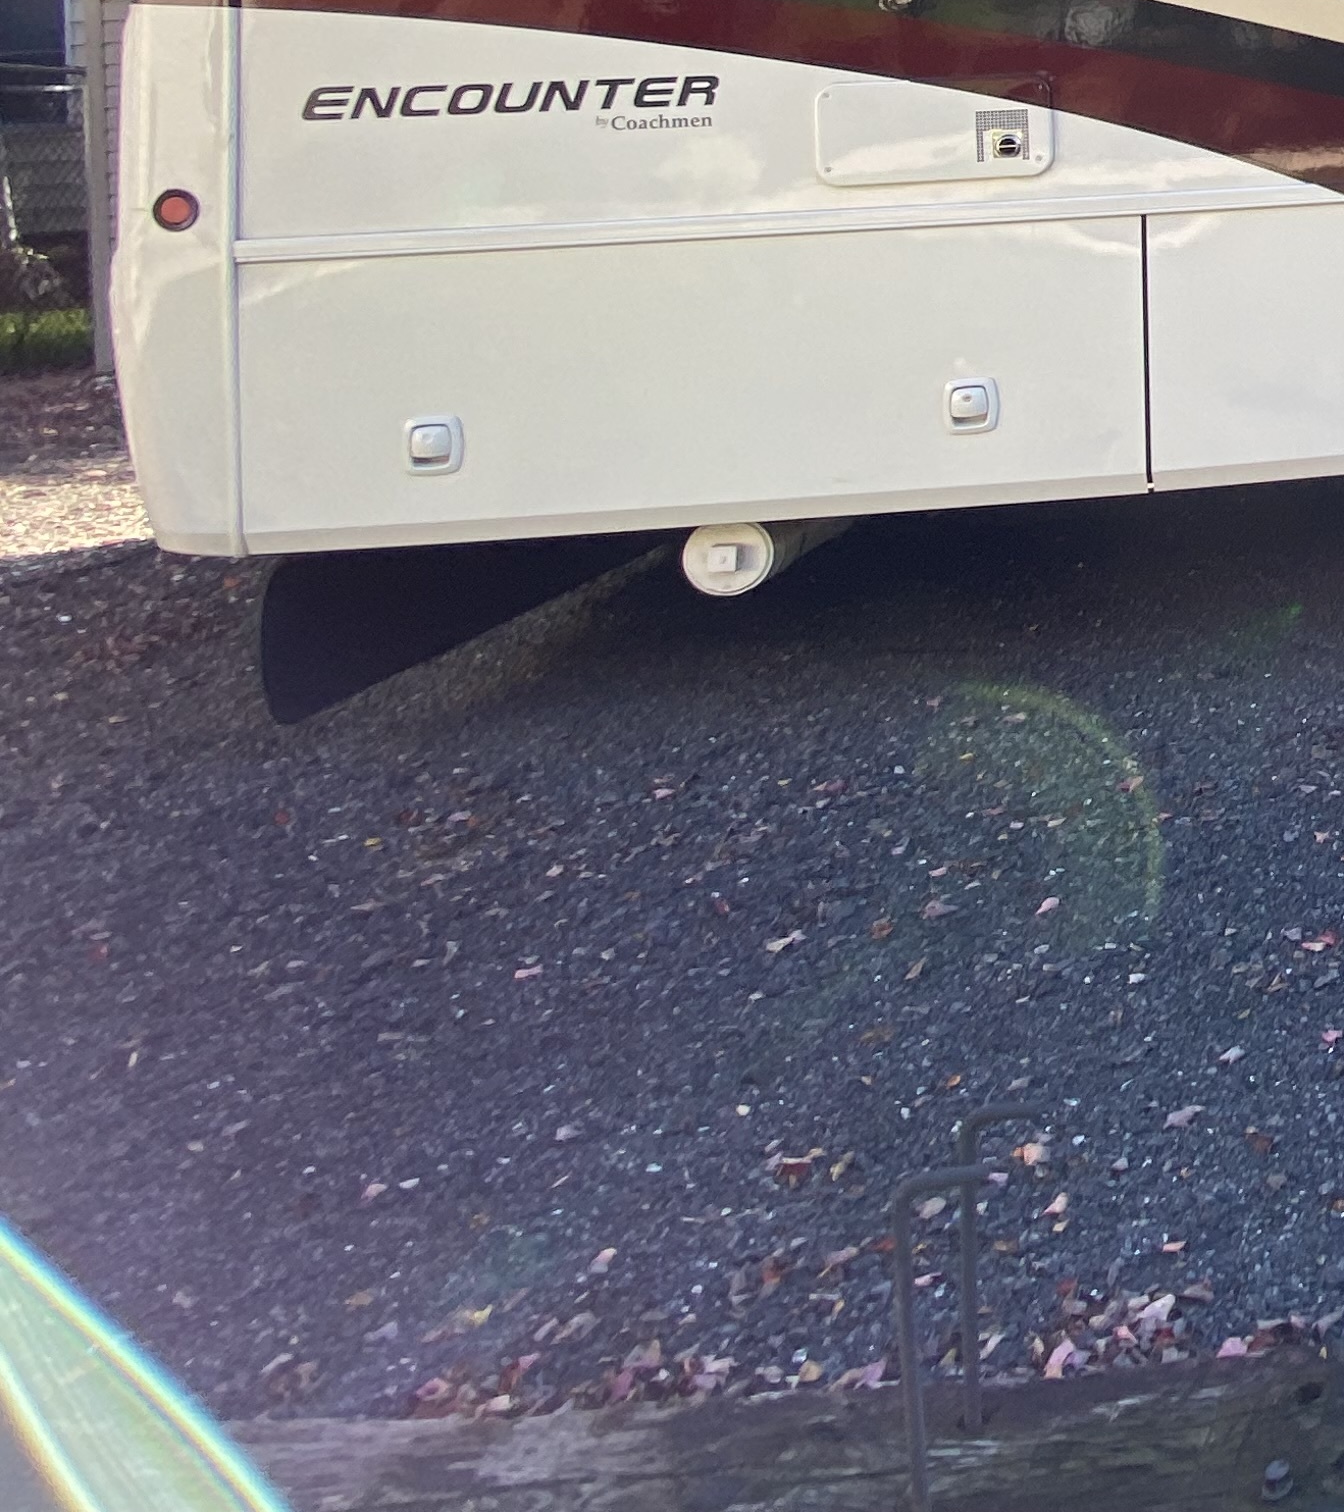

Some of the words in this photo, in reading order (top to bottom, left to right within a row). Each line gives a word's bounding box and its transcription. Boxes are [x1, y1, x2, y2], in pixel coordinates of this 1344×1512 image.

[302, 75, 720, 121] ENCOUNTER
[595, 115, 609, 128] by
[611, 114, 713, 131] Coachmen
